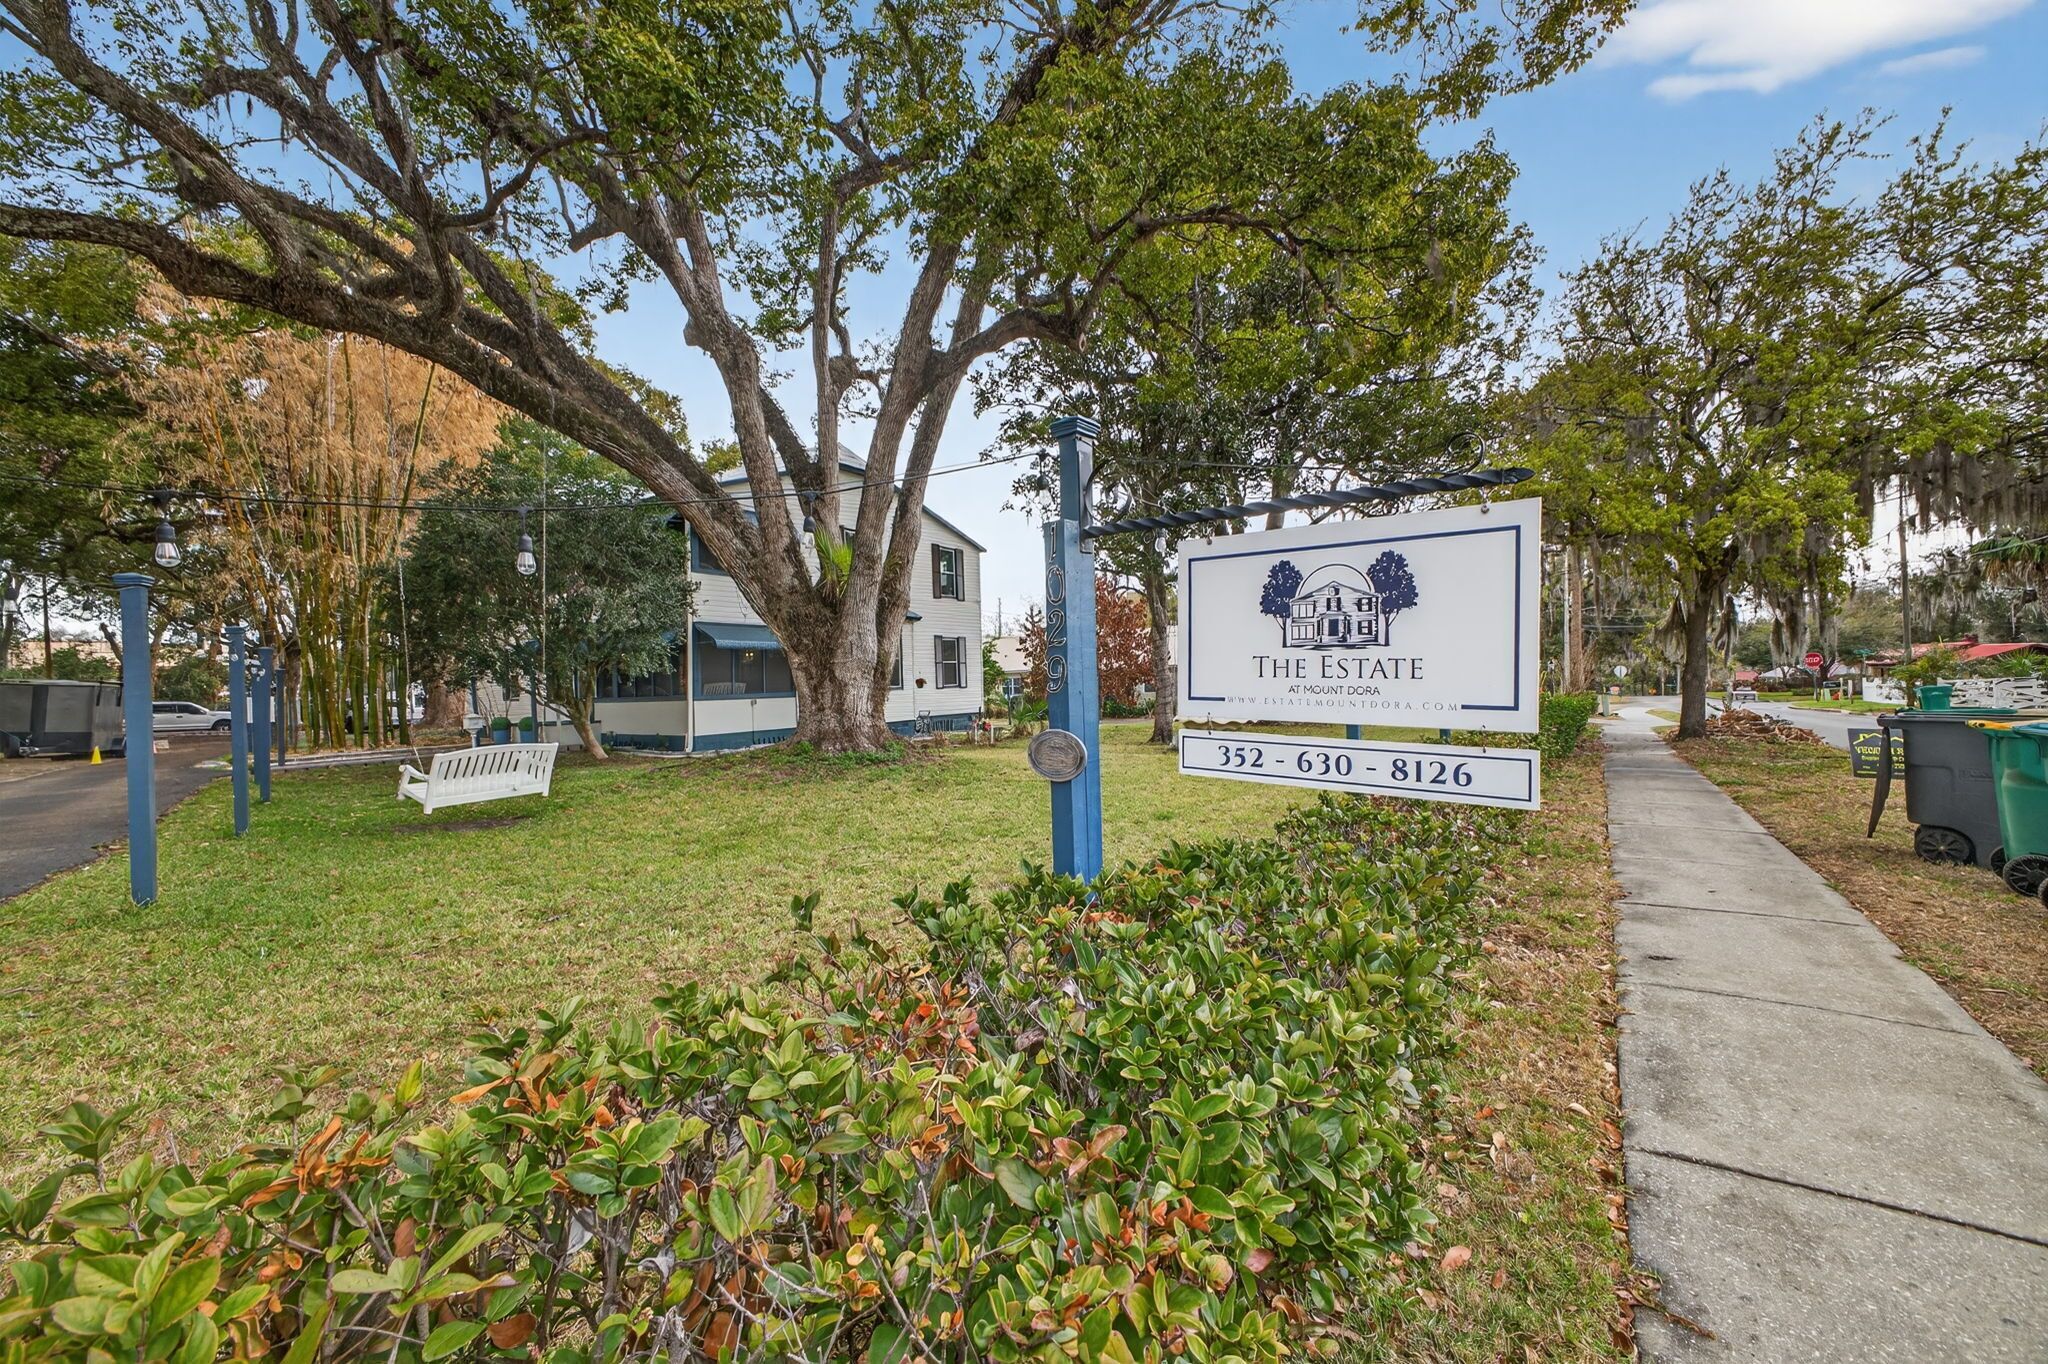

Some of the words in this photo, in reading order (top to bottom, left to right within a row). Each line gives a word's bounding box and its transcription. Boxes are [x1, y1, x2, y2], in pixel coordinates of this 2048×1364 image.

[1046, 522, 1067, 693] 1029
[1252, 655, 1306, 678] THE
[1321, 655, 1424, 680] ESTATE
[1288, 685, 1300, 694] AT
[1304, 685, 1344, 695] MOUNT
[1347, 685, 1380, 696] DORA
[1218, 745, 1264, 768] 352
[1297, 750, 1353, 776] 630
[1391, 758, 1473, 787] 8126
